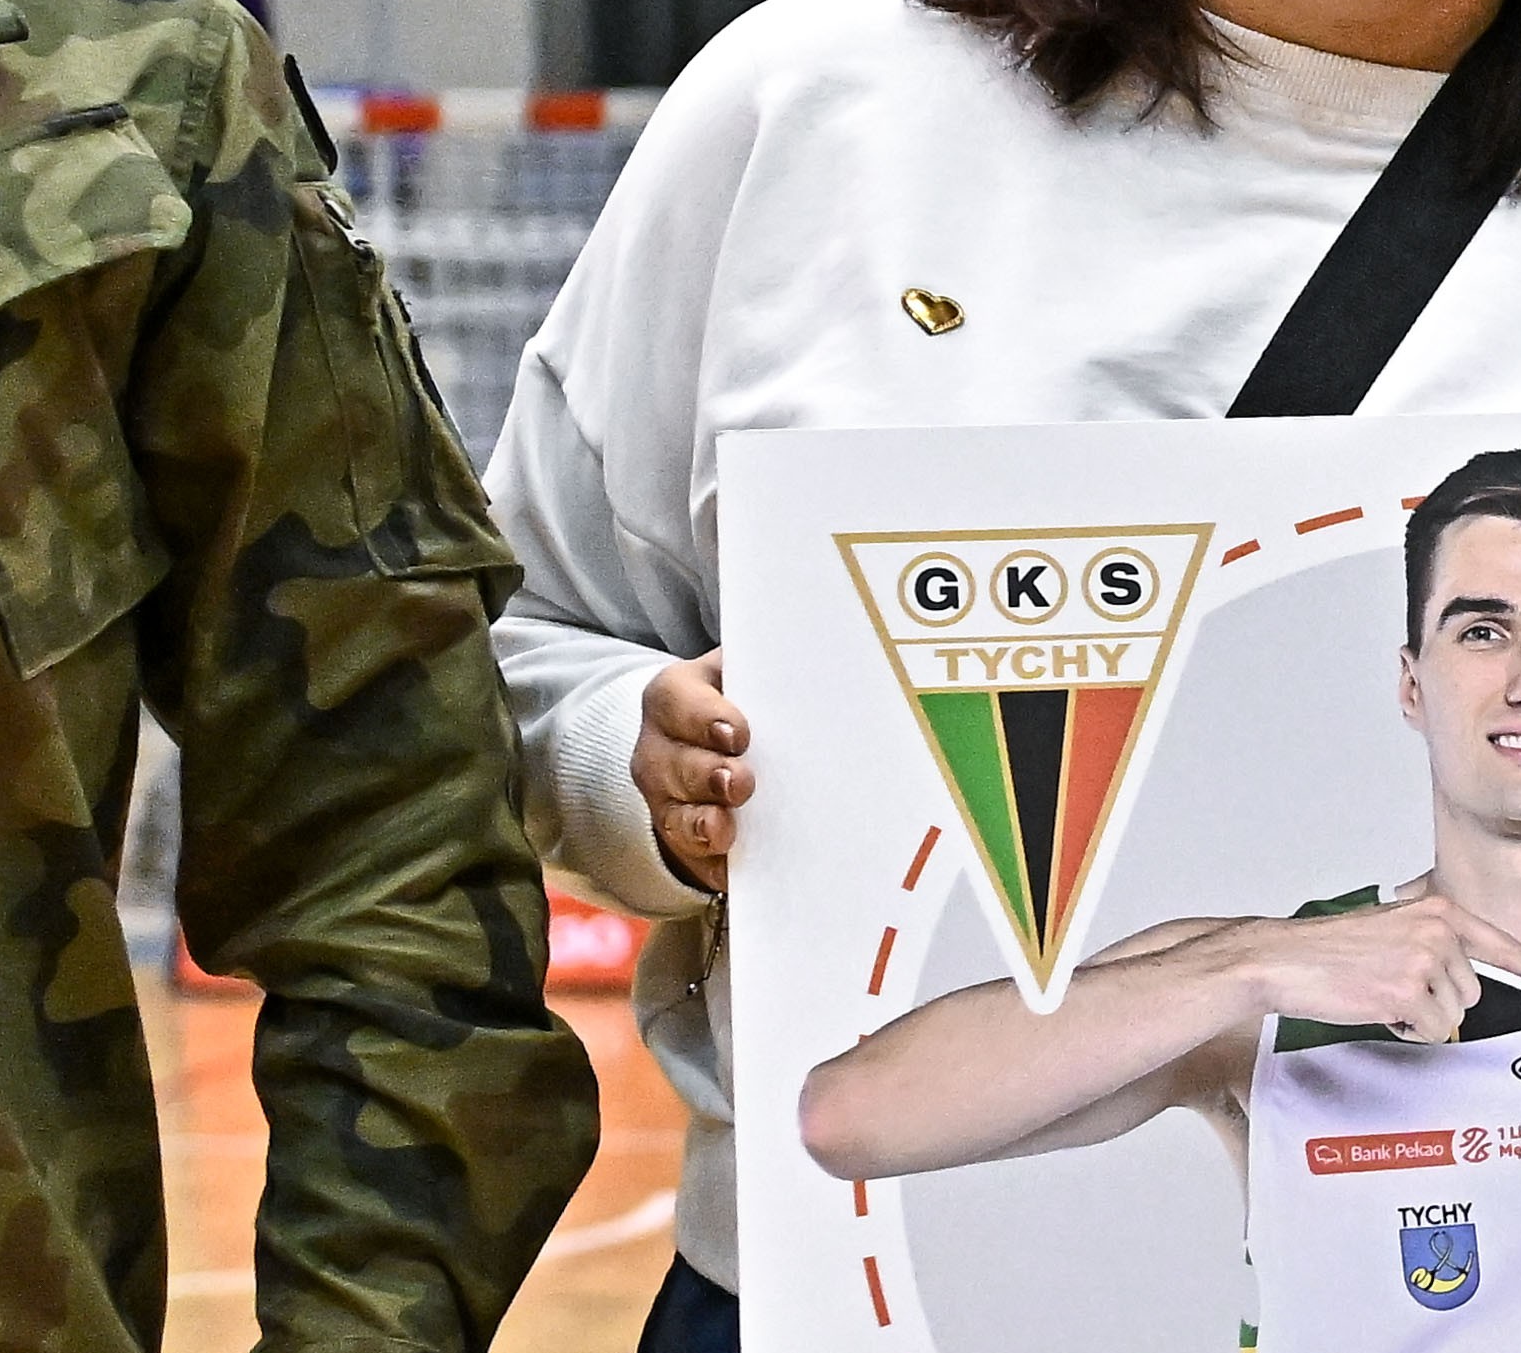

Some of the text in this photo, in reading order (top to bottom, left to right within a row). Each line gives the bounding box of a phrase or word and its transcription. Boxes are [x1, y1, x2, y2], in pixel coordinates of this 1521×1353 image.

[914, 561, 1142, 611] GKS
[933, 643, 1132, 681] TYCHY
[1497, 1126, 1506, 1140] 1
[1350, 1142, 1445, 1163] Bank Pekao
[1397, 1202, 1474, 1227] TYCHY
